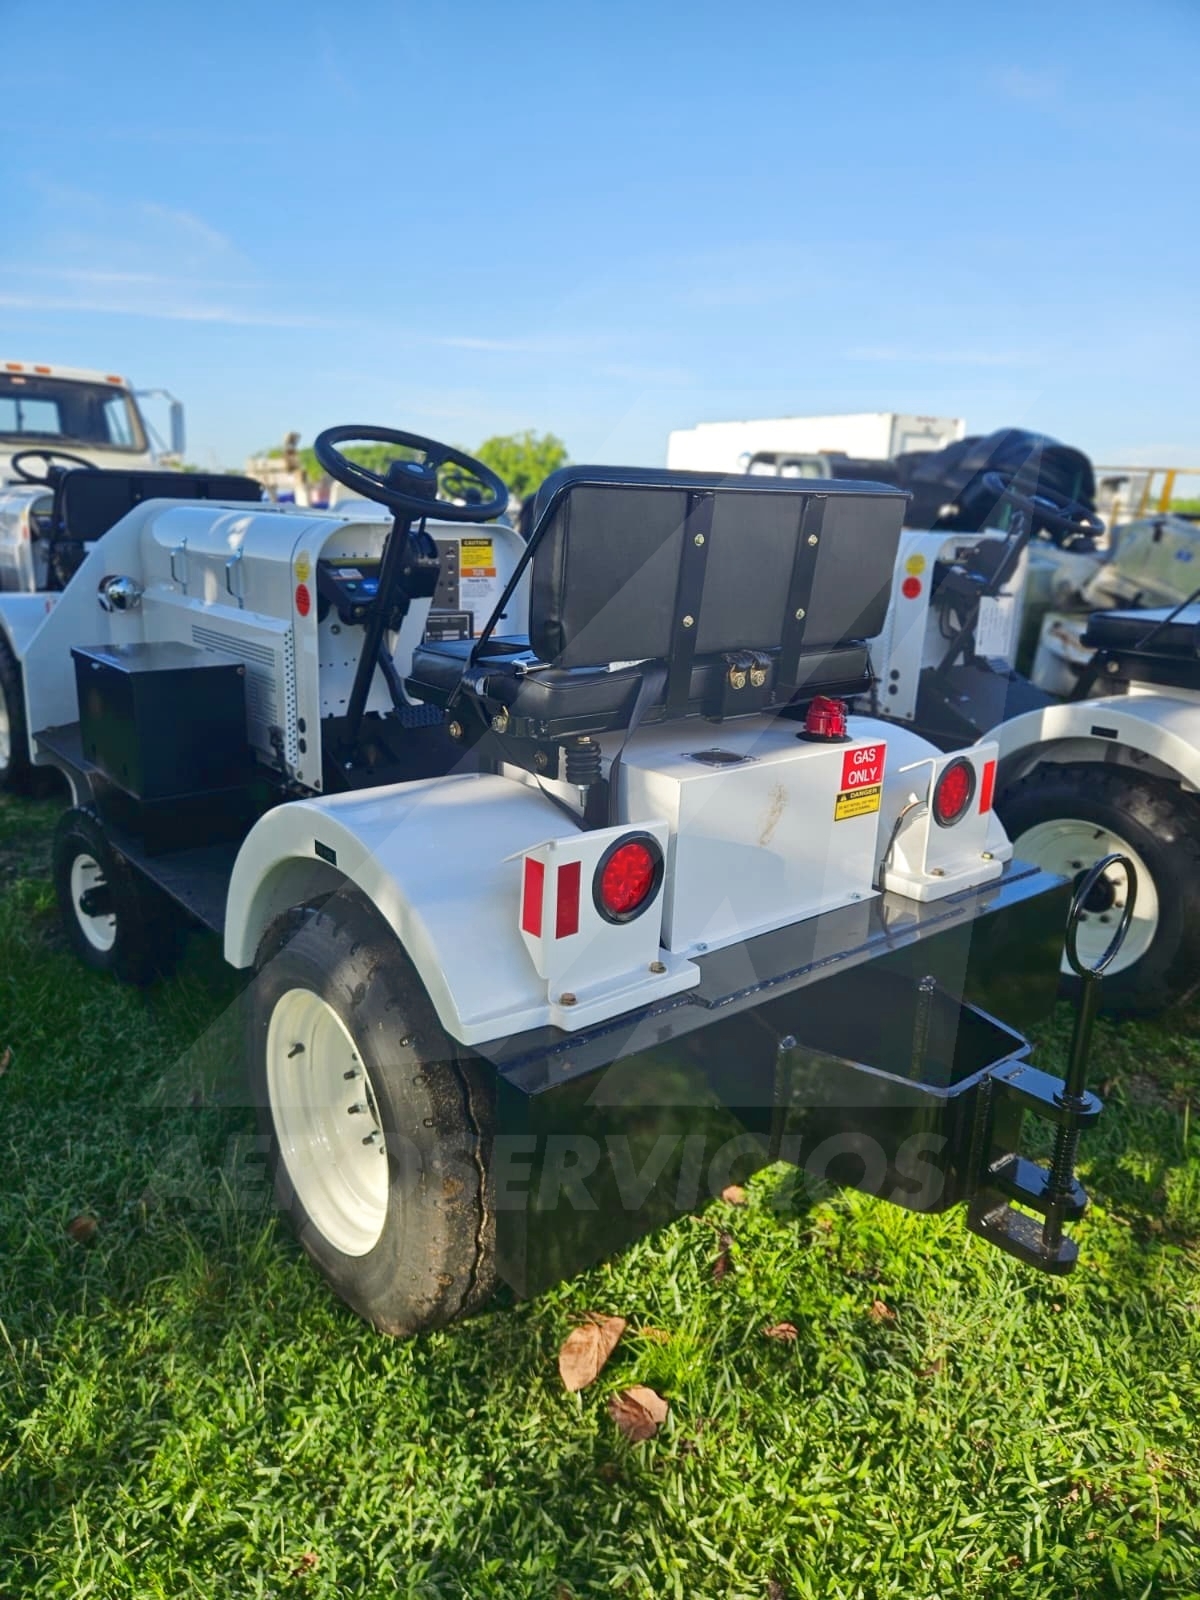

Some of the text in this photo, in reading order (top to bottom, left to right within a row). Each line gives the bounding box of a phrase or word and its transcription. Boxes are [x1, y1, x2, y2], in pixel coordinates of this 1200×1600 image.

[853, 748, 876, 765] GAS
[848, 767, 878, 785] ONLY
[850, 787, 878, 799] DANGER
